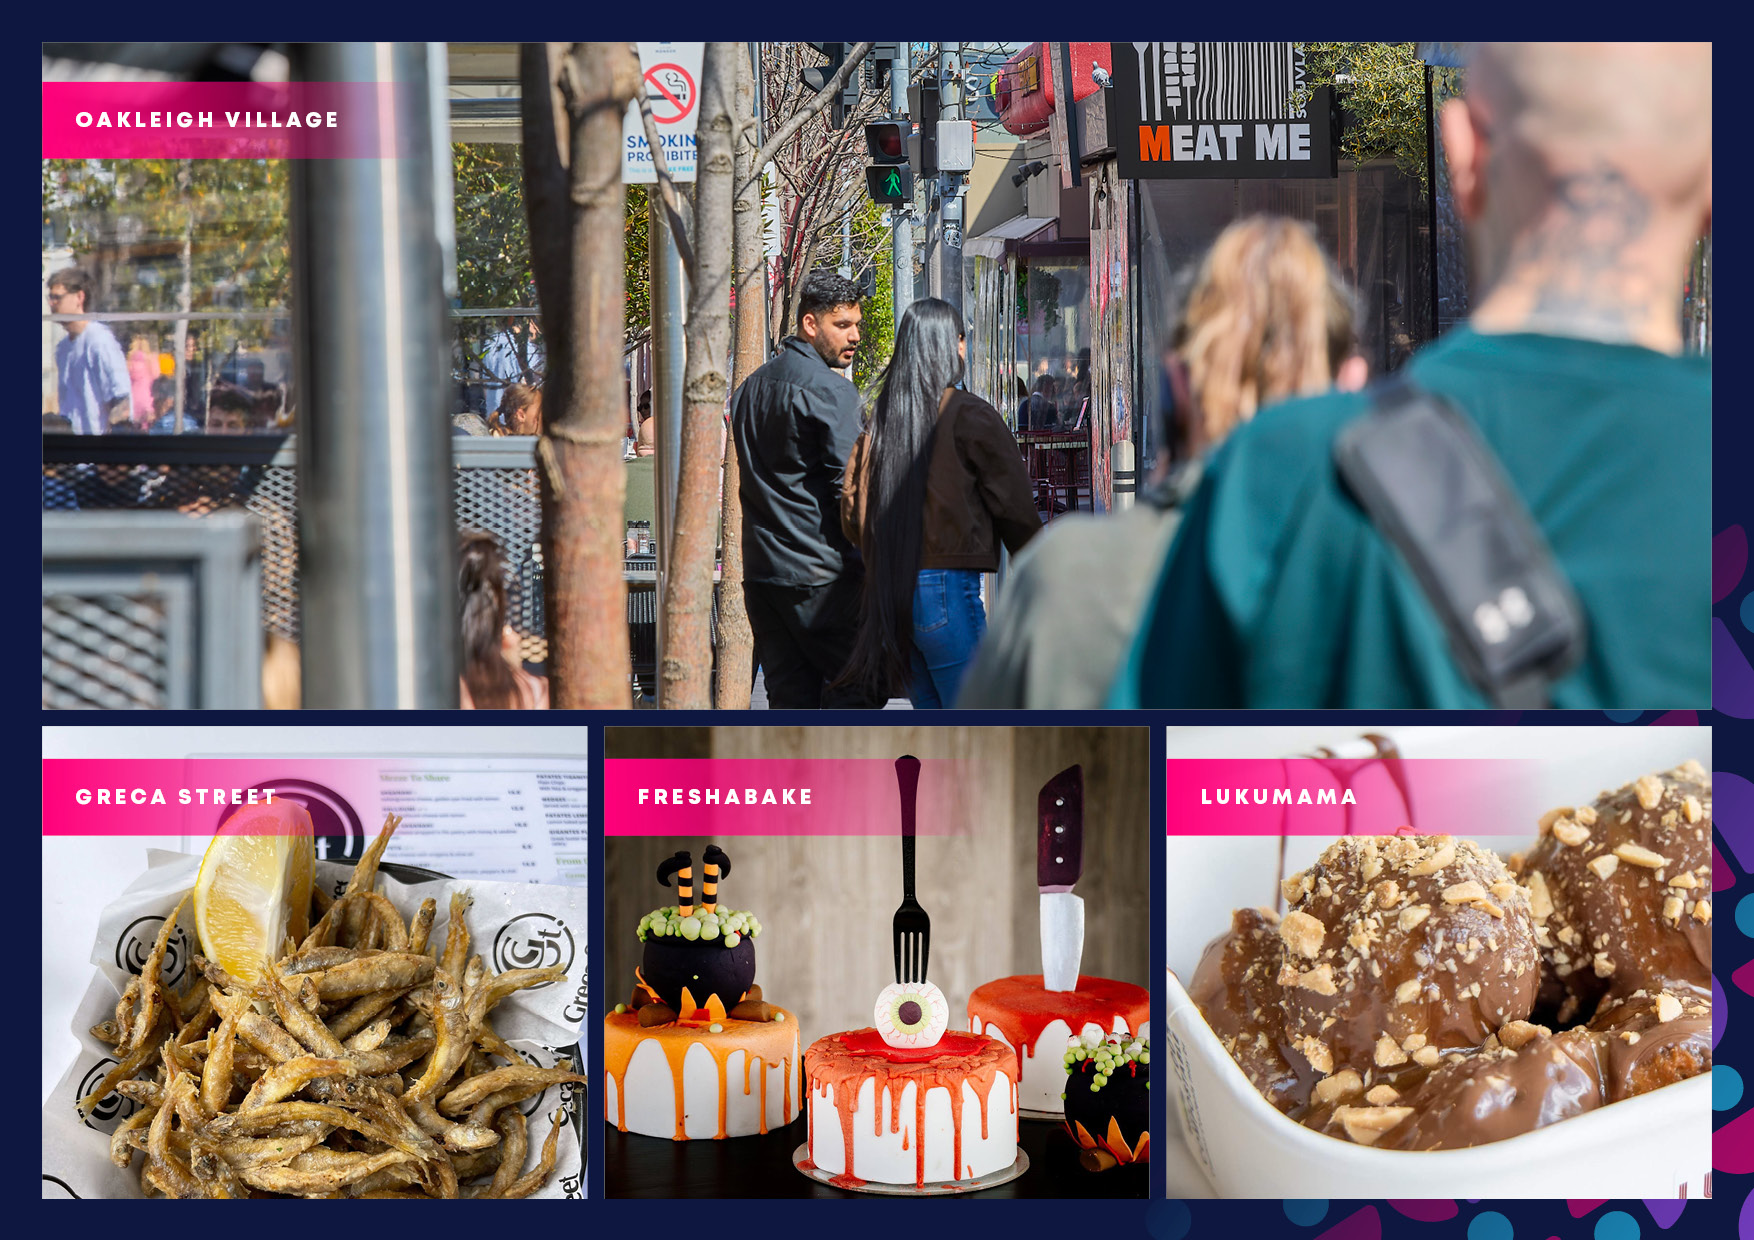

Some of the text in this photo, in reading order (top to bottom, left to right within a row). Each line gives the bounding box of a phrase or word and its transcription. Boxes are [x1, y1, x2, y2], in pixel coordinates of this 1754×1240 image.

[627, 134, 696, 148] SMOKIN
[1139, 123, 1311, 161] MEAT ME
[627, 150, 698, 161] PROIBITE
